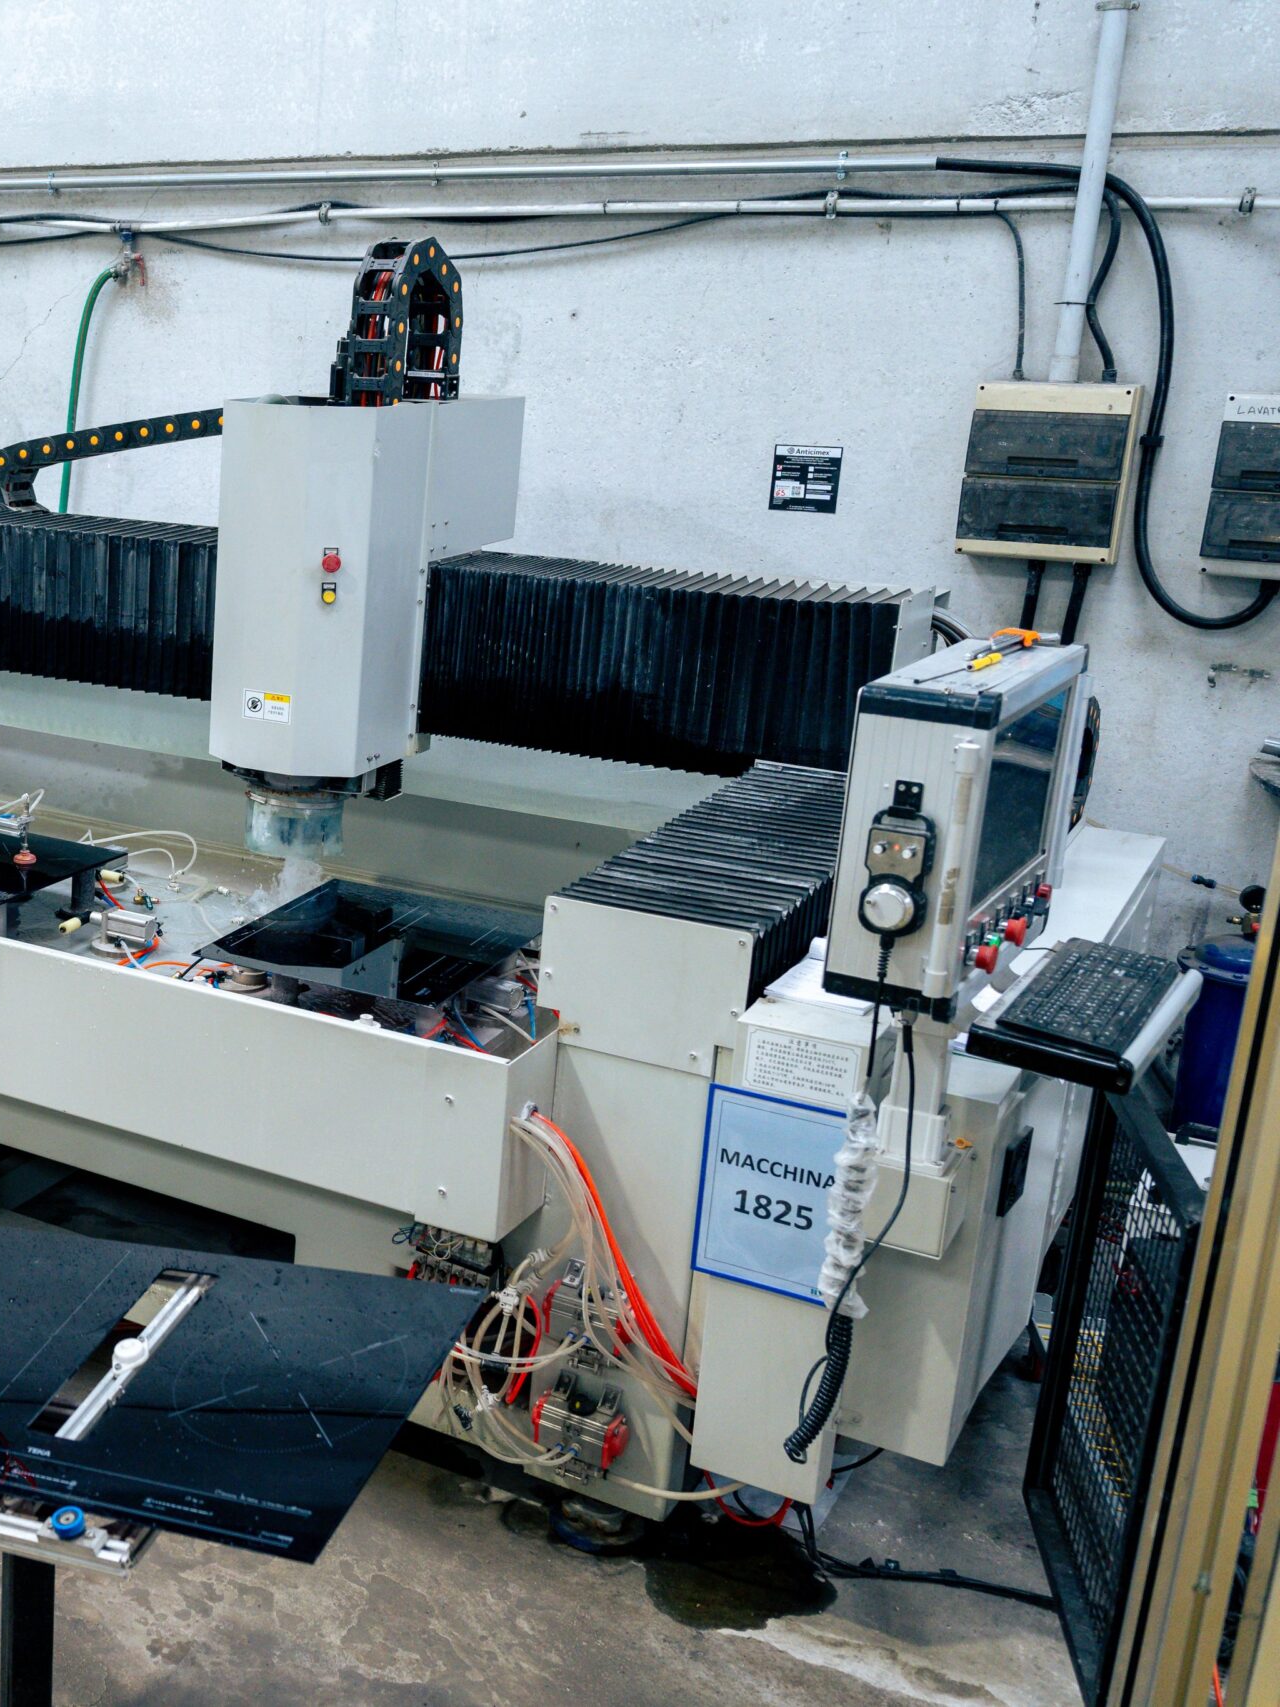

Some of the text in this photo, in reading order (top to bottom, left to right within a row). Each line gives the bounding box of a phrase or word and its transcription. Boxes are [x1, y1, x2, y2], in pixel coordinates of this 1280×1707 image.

[796, 448, 830, 456] Anticimex
[720, 1148, 836, 1189] MACCHINA
[734, 1189, 813, 1231] 1825
